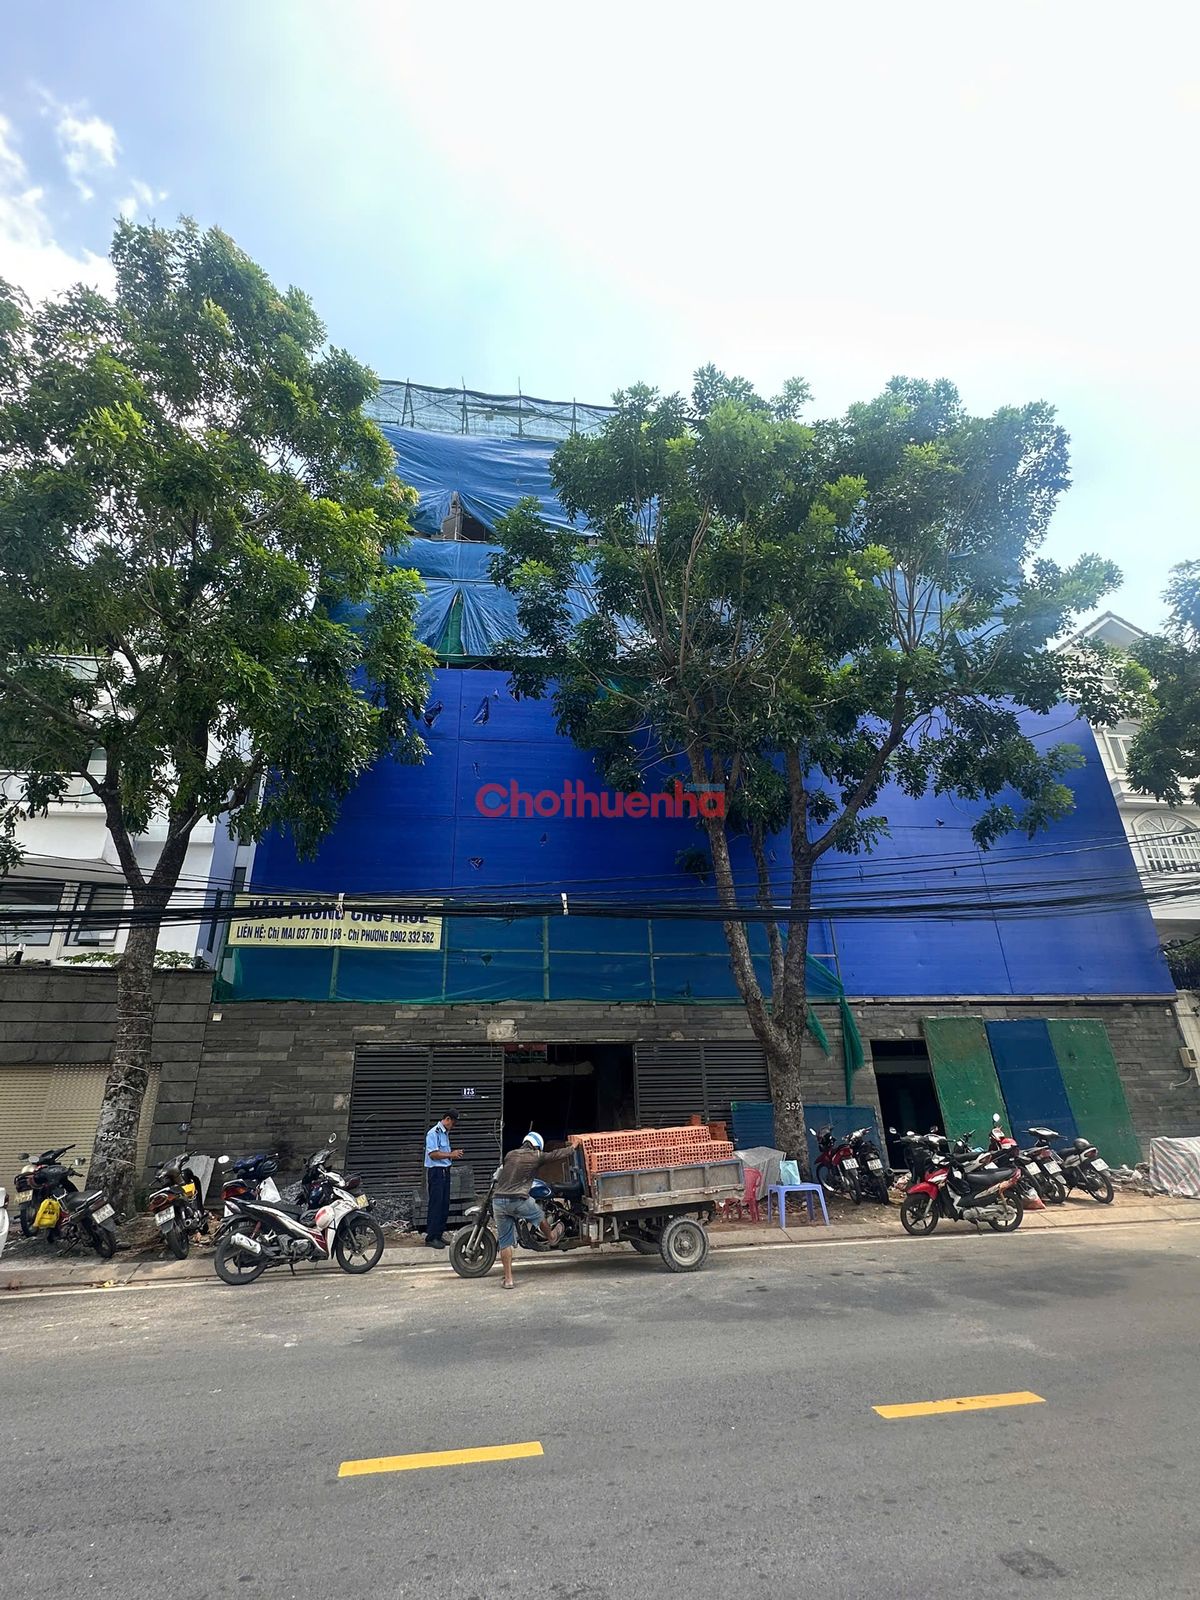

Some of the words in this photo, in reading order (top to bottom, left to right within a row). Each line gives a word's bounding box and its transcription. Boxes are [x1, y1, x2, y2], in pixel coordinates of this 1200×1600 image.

[236, 923, 254, 939] LIÊN
[254, 924, 266, 941] HỆ:
[267, 926, 280, 942] Chị
[281, 927, 295, 940] MAI
[296, 928, 310, 940] 037
[311, 928, 329, 940] 7610
[330, 928, 342, 940] 168
[348, 928, 359, 944] Chị
[360, 928, 389, 942] PHƯƠNG
[389, 930, 406, 943] 0902
[407, 931, 420, 943] 332
[421, 931, 435, 944] 562
